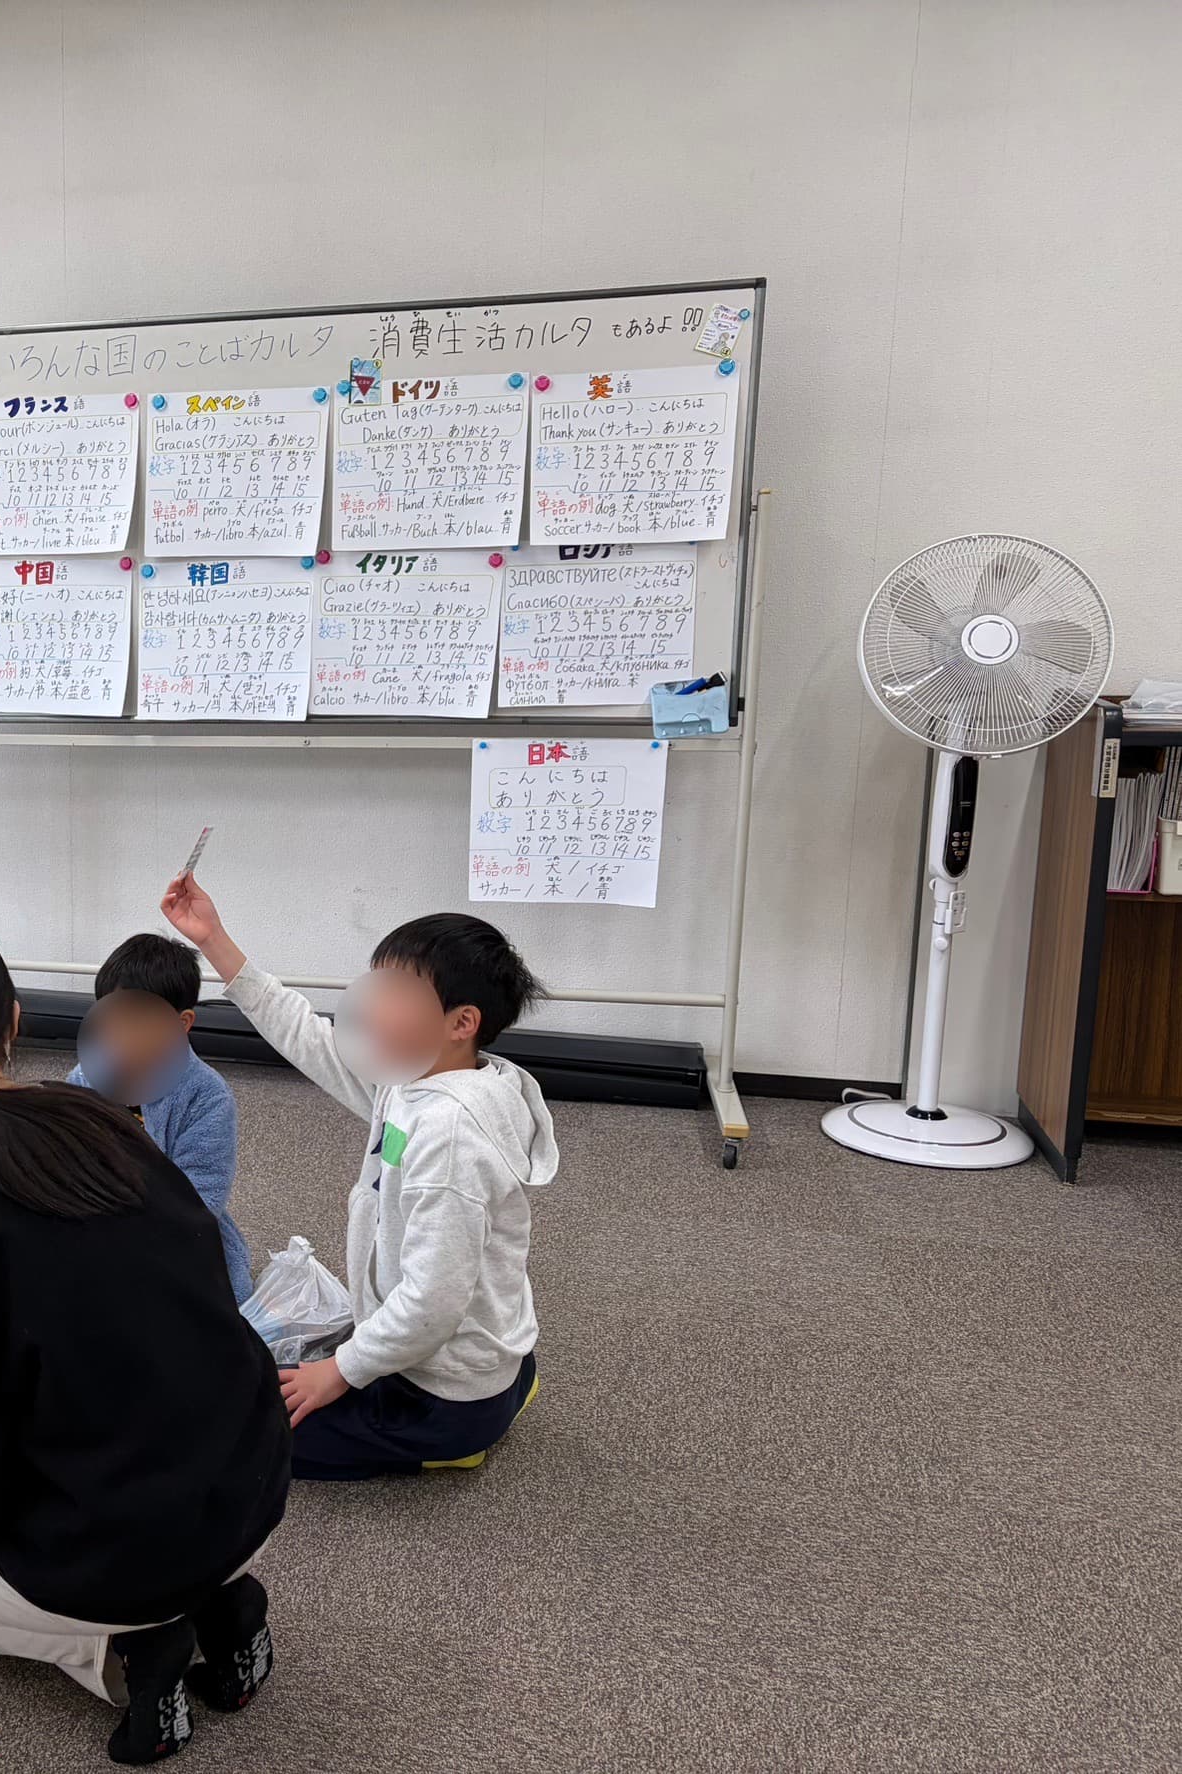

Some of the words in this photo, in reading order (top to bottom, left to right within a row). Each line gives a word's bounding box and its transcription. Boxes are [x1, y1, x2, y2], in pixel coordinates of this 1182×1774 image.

[392, 380, 458, 403] ドイツ語
[587, 375, 633, 400] 英語
[341, 407, 386, 425] Guten
[484, 403, 522, 414] こんにちは
[649, 399, 704, 413] こんにちは
[233, 415, 285, 426] こんにちは
[449, 425, 500, 438] ありがとう
[542, 426, 574, 440] Thank
[663, 422, 719, 435] ありがとう
[77, 441, 127, 455] ありがとう
[268, 434, 315, 447] ありがとう
[397, 497, 424, 512] Hund
[496, 494, 517, 503] イチゴ
[538, 497, 594, 517] 単語の例
[595, 501, 617, 517] dog
[701, 494, 725, 507] イチゴ
[33, 515, 58, 526] chien
[203, 507, 228, 522] perro
[501, 516, 512, 534] 青
[14, 560, 68, 585] 中国語
[356, 553, 438, 575] イタリア語
[187, 562, 246, 587] 韓国語
[418, 581, 470, 592] こんにちは
[634, 578, 680, 589] こんにちは
[77, 590, 123, 601] こんにちは
[634, 594, 684, 607] ありがとう
[71, 610, 117, 623] ありがとう
[267, 611, 306, 624] ありがとう
[432, 602, 486, 618] ありがとう
[82, 665, 104, 677] イチゴ
[275, 682, 301, 696] イチゴ
[528, 743, 590, 765] 日本語
[497, 768, 609, 785] こんにちは
[496, 788, 605, 809] ありがとう
[477, 816, 513, 833] 数字
[526, 816, 535, 831] 1
[541, 816, 551, 829] 2
[557, 816, 567, 830] 3
[572, 816, 584, 830] 4
[587, 816, 598, 830] 5
[601, 816, 610, 830] 6
[616, 816, 623, 831] 7
[624, 818, 637, 831] 8
[642, 818, 652, 833] 9
[516, 844, 530, 856] 10
[538, 843, 553, 854] 11
[564, 843, 581, 855] 12
[591, 842, 606, 856] 13
[611, 842, 627, 859] 14
[634, 845, 651, 860] 15
[472, 860, 530, 877] 単語の例
[546, 861, 561, 875] 犬
[586, 862, 625, 875] イチゴ
[478, 880, 521, 897] サッカー
[543, 882, 563, 896] 本
[595, 881, 610, 900] 青
